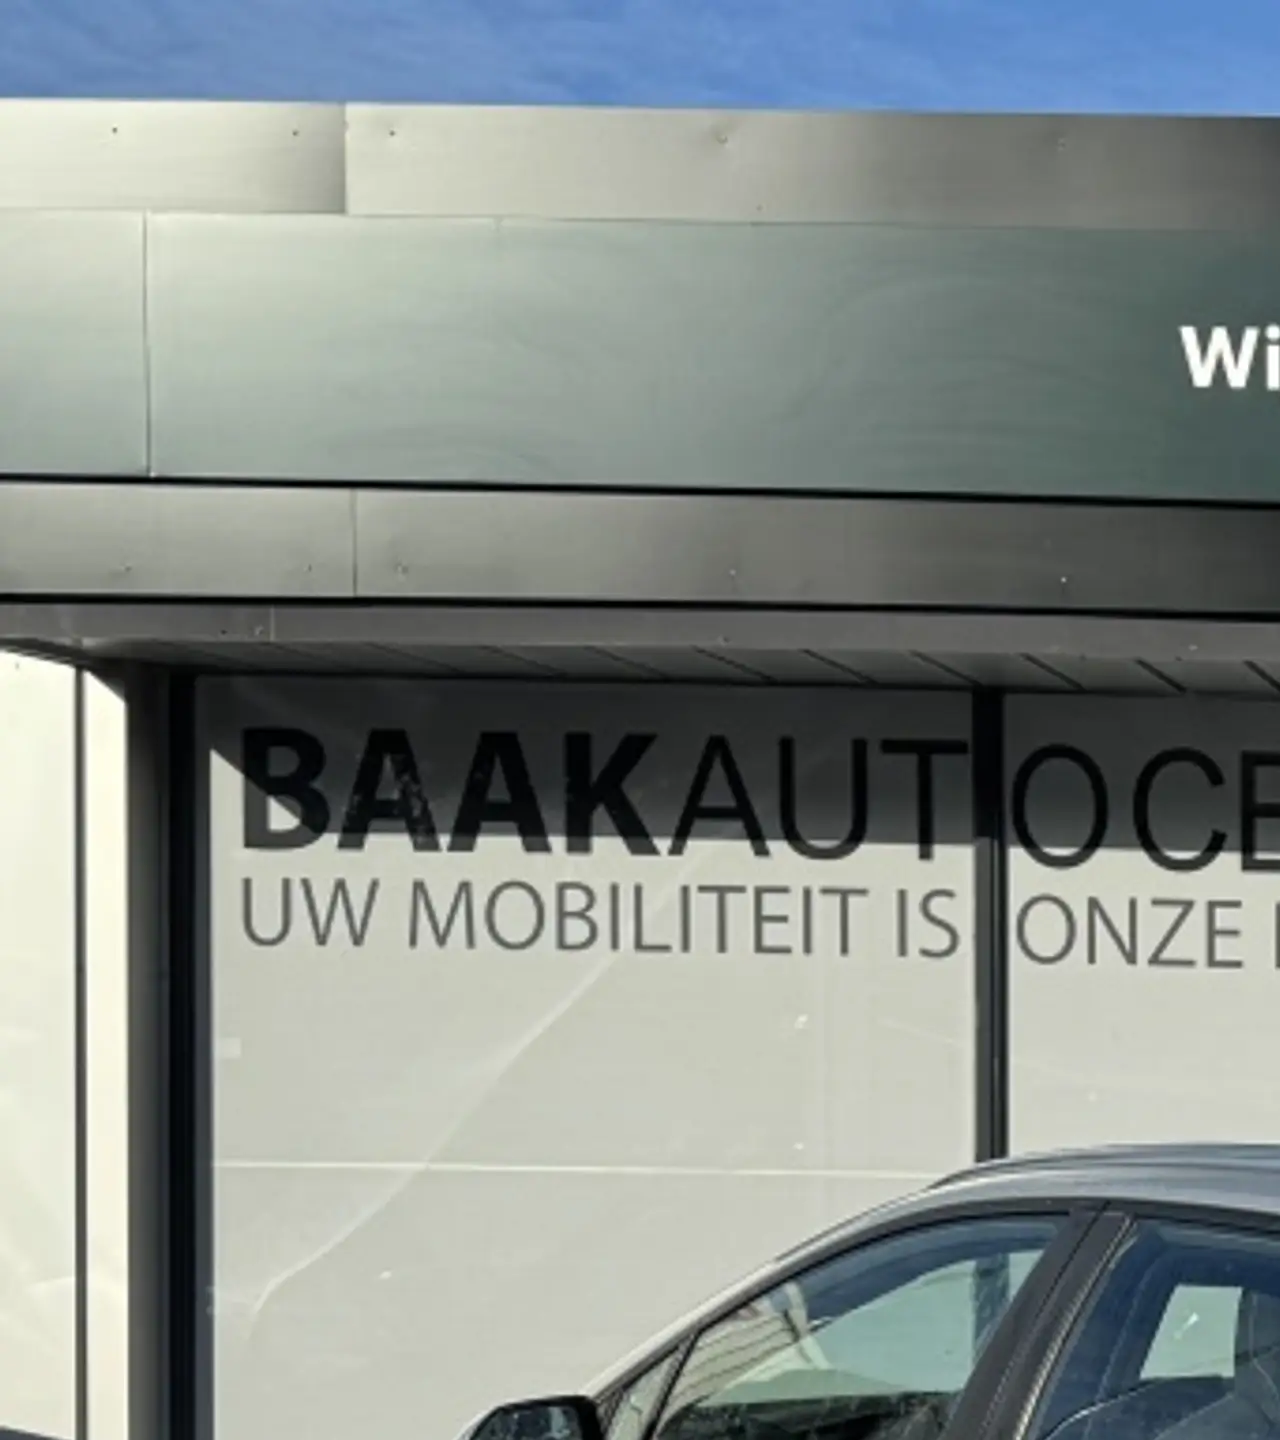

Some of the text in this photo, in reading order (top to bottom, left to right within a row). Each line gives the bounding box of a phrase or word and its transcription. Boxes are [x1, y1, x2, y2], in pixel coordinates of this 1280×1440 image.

[240, 876, 381, 947] UW
[407, 879, 870, 957] MOBILITEIT
[896, 888, 961, 959] IS
[1016, 893, 1245, 970] ONZE
